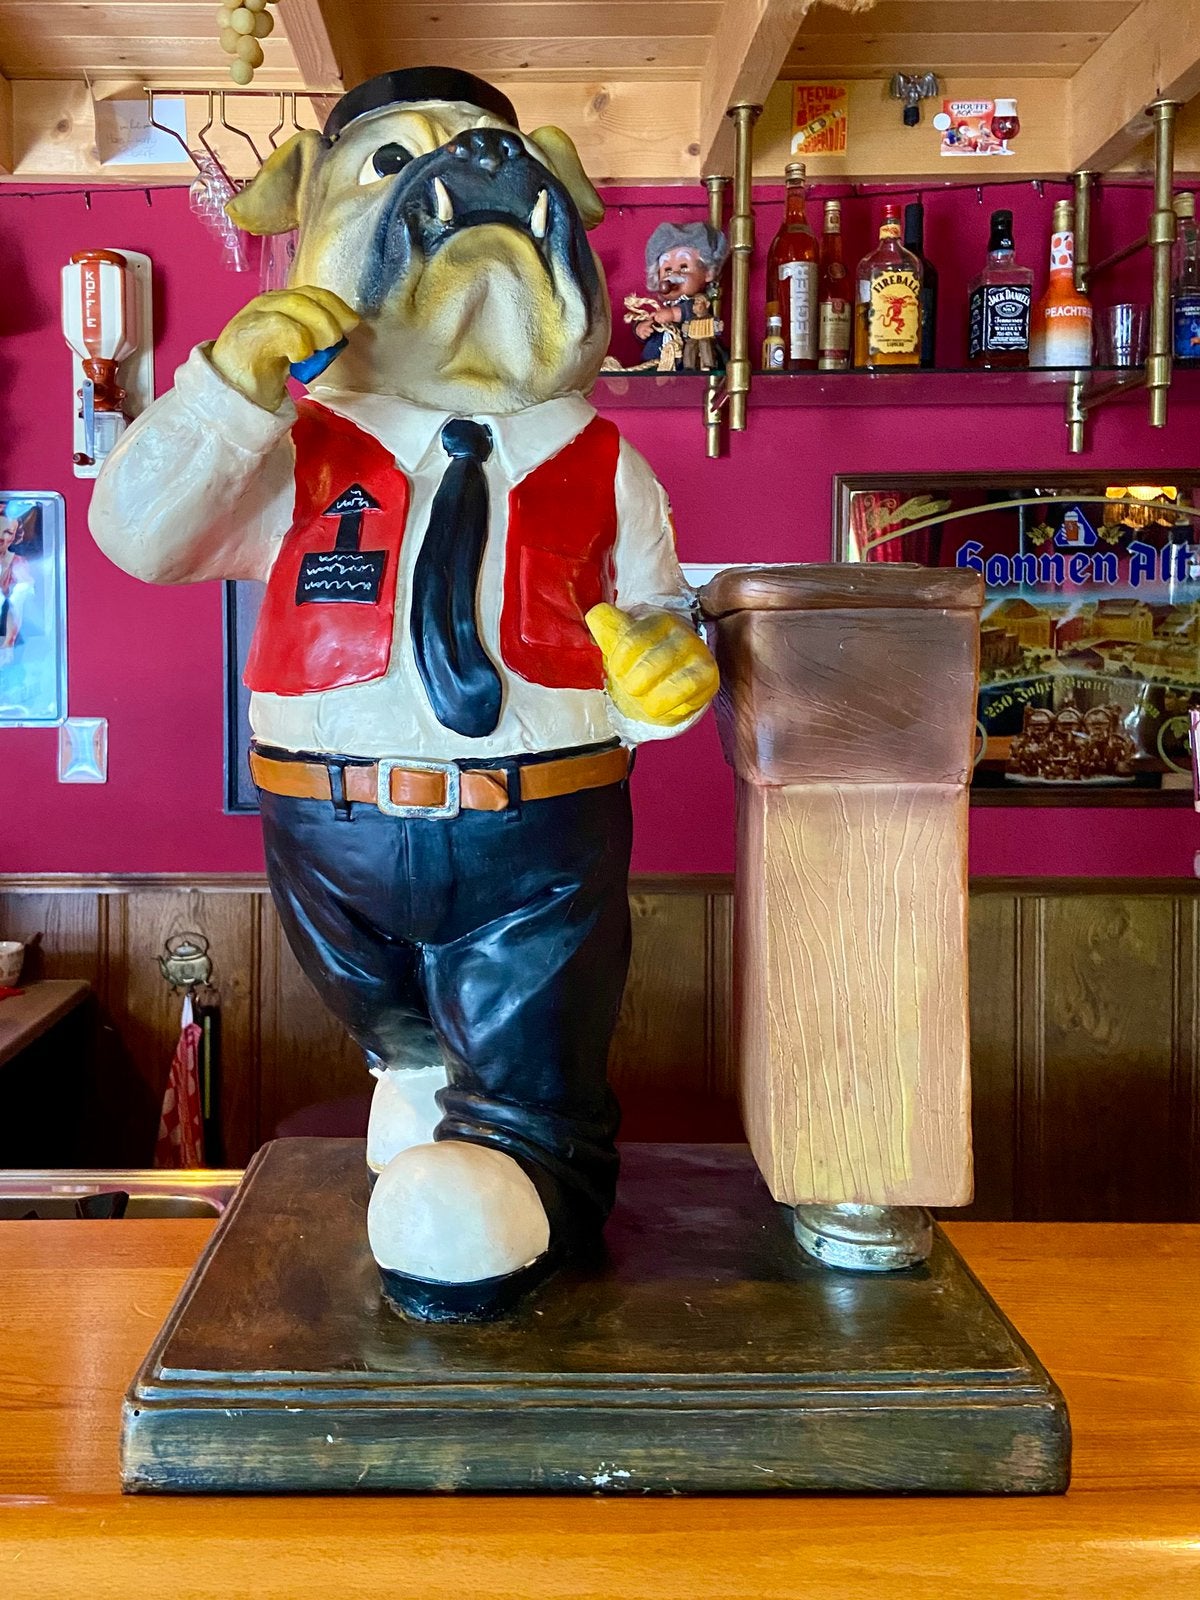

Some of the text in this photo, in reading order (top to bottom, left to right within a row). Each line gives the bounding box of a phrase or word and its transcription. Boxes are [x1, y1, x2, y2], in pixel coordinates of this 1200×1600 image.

[873, 274, 920, 295] FIREBALL
[85, 271, 97, 328] KOFFIE
[988, 291, 1005, 306] JACK
[1126, 540, 1194, 588] Alt
[984, 694, 1013, 718] 250
